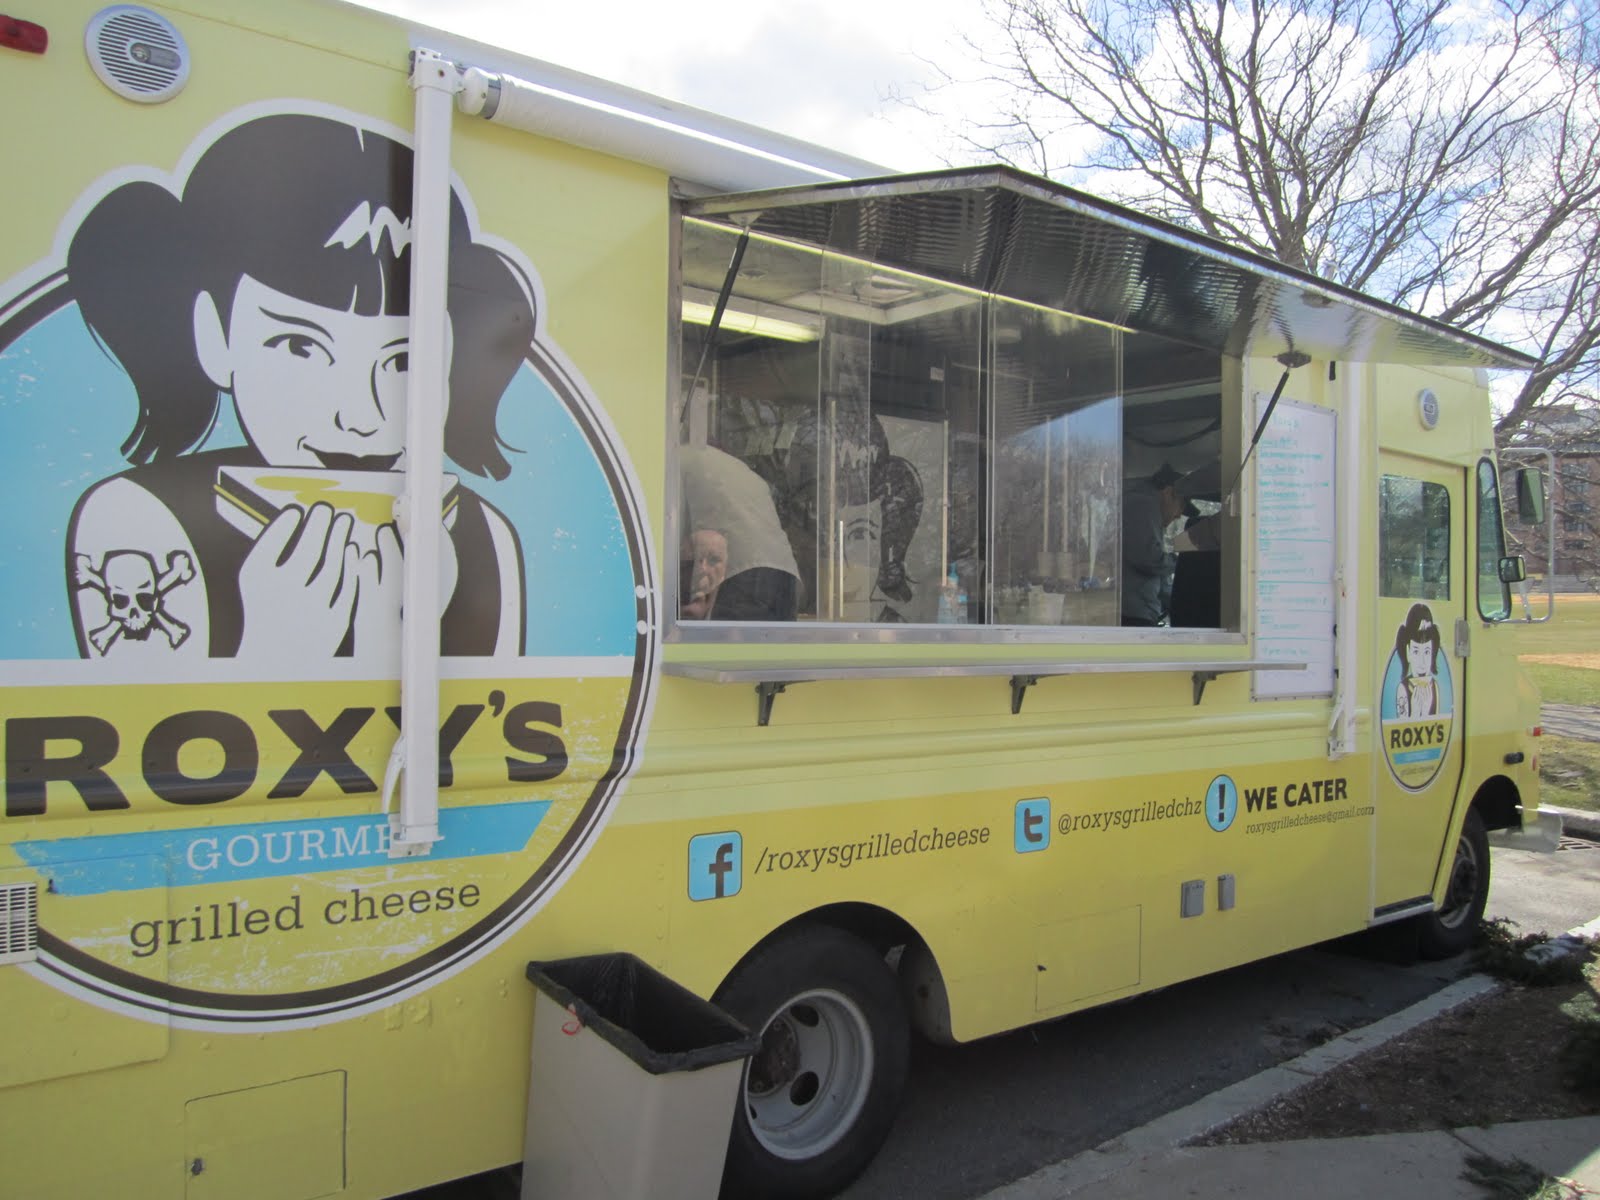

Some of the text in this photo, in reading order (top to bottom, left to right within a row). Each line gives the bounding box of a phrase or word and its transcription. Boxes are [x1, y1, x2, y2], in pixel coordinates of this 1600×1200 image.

[5, 689, 569, 816] ROXY'S
[1391, 722, 1444, 749] ROXY'S
[1058, 797, 1202, 835] @roxysgrilledchz
[1244, 778, 1348, 813] WE CATER
[1246, 805, 1375, 834] roxysgrilledcheese@gmail.com
[186, 824, 390, 871] GOURME
[754, 827, 990, 874] /roxysgrilledcheese
[129, 883, 481, 957] grilled cheese
